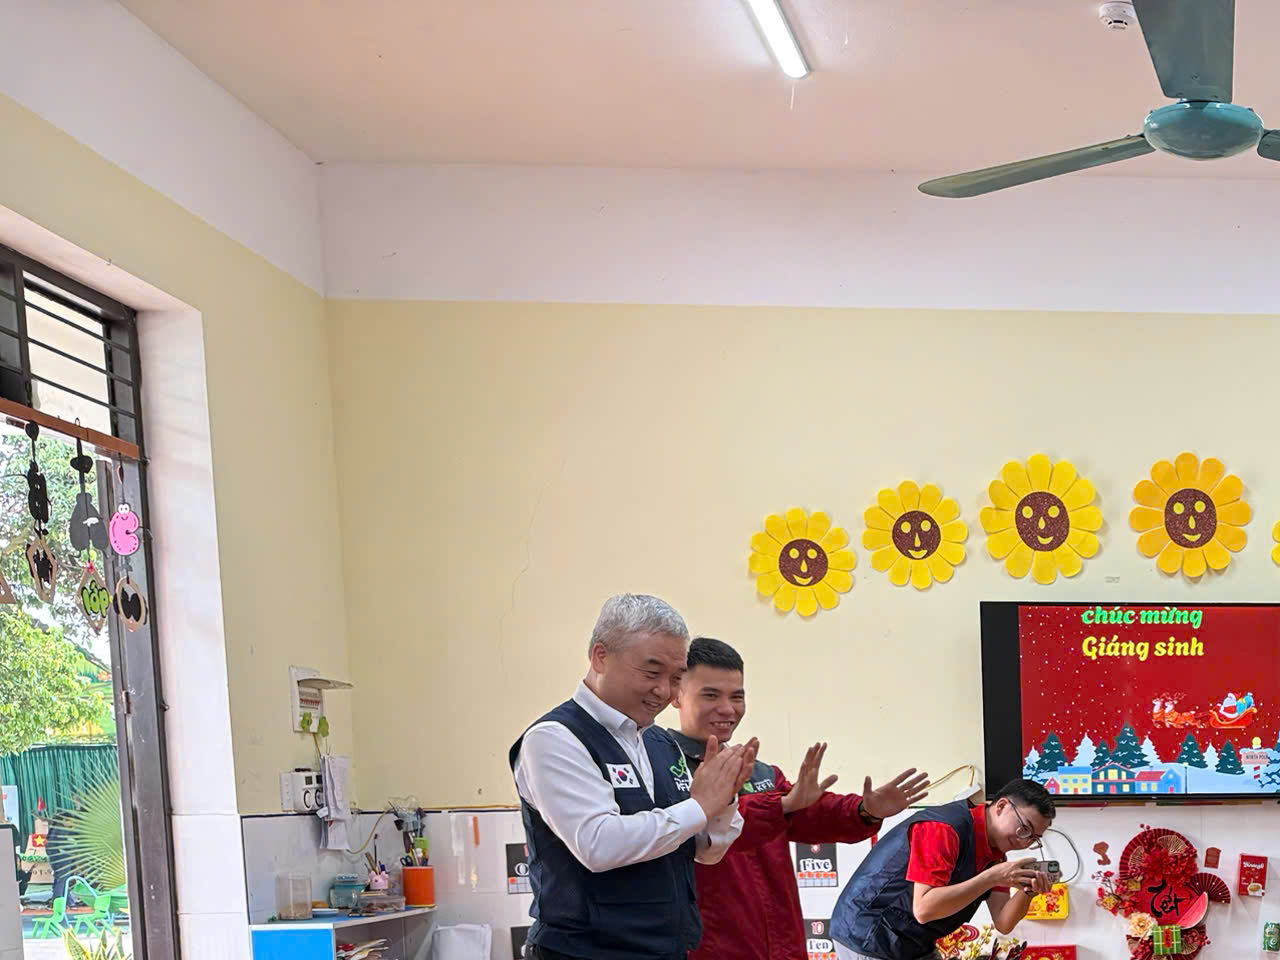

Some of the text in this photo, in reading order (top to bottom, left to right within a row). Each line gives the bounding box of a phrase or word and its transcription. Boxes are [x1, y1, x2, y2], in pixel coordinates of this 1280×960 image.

[1082, 606, 1203, 629] chúc mừng
[1082, 635, 1204, 662] Giáng sinh
[802, 860, 831, 872] Five
[1147, 880, 1185, 918] Tết
[811, 922, 824, 935] 10
